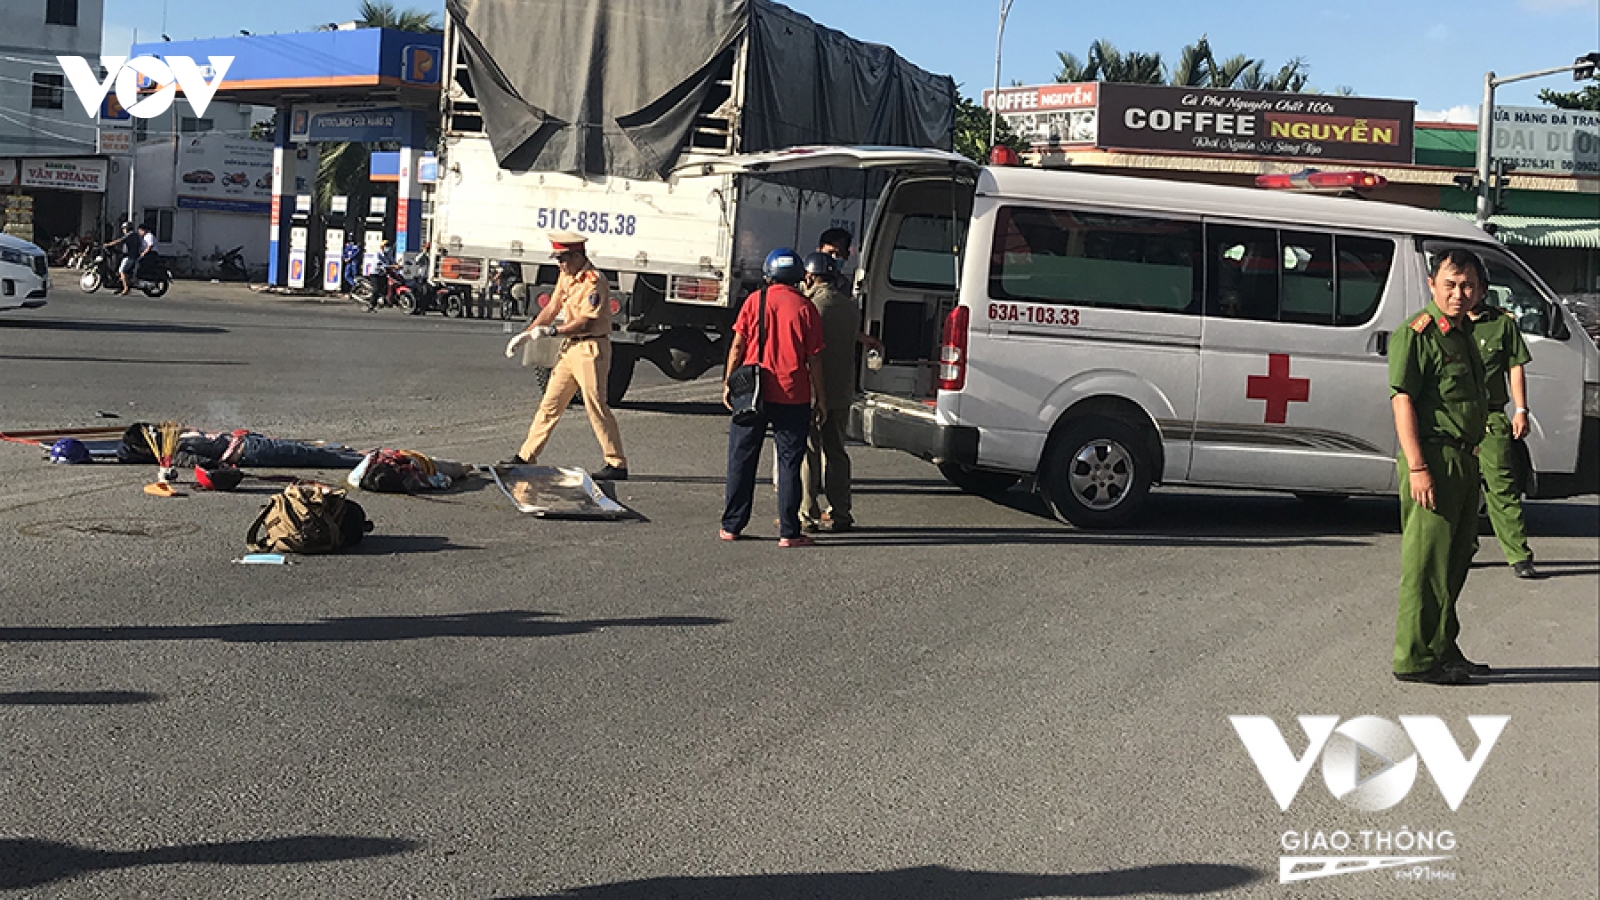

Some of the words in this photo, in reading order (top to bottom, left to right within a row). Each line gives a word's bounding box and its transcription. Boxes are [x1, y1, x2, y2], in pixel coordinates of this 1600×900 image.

[988, 91, 1038, 110] COFFEE
[1124, 108, 1256, 135] COFFEE
[1270, 119, 1393, 143] NGUYỄN
[537, 207, 636, 236] 51C-835.38
[988, 303, 1080, 326] 63A-103.33
